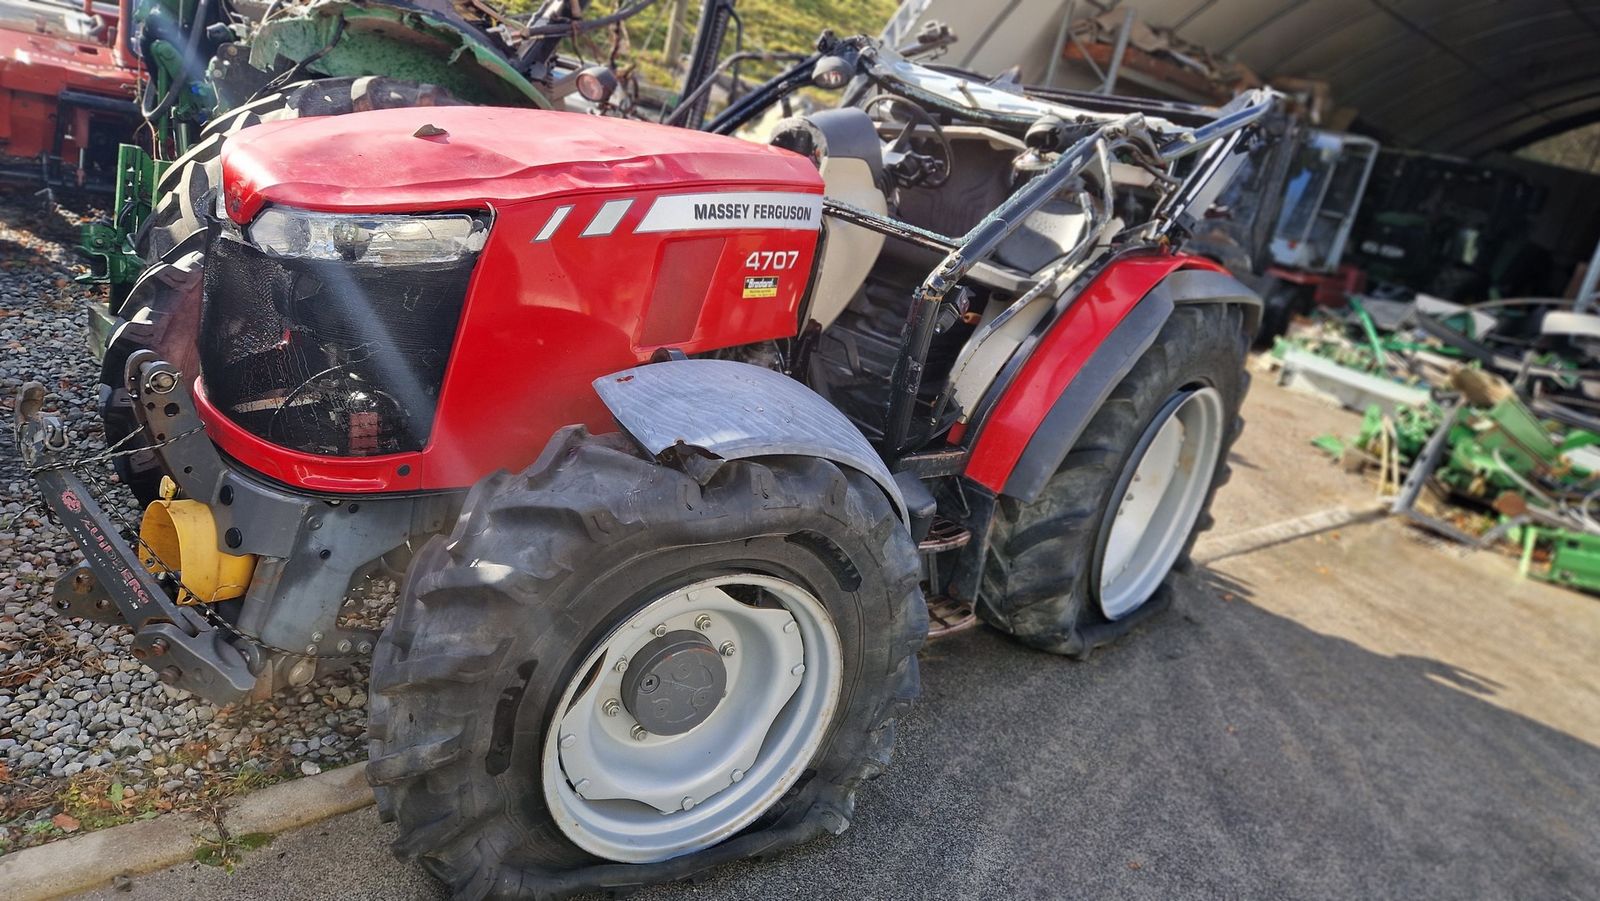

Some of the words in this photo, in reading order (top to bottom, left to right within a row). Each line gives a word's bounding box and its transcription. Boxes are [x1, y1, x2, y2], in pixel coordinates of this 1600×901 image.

[694, 203, 750, 220] MASSEY
[753, 204, 812, 221] FERGUSON
[745, 251, 799, 270] 4707
